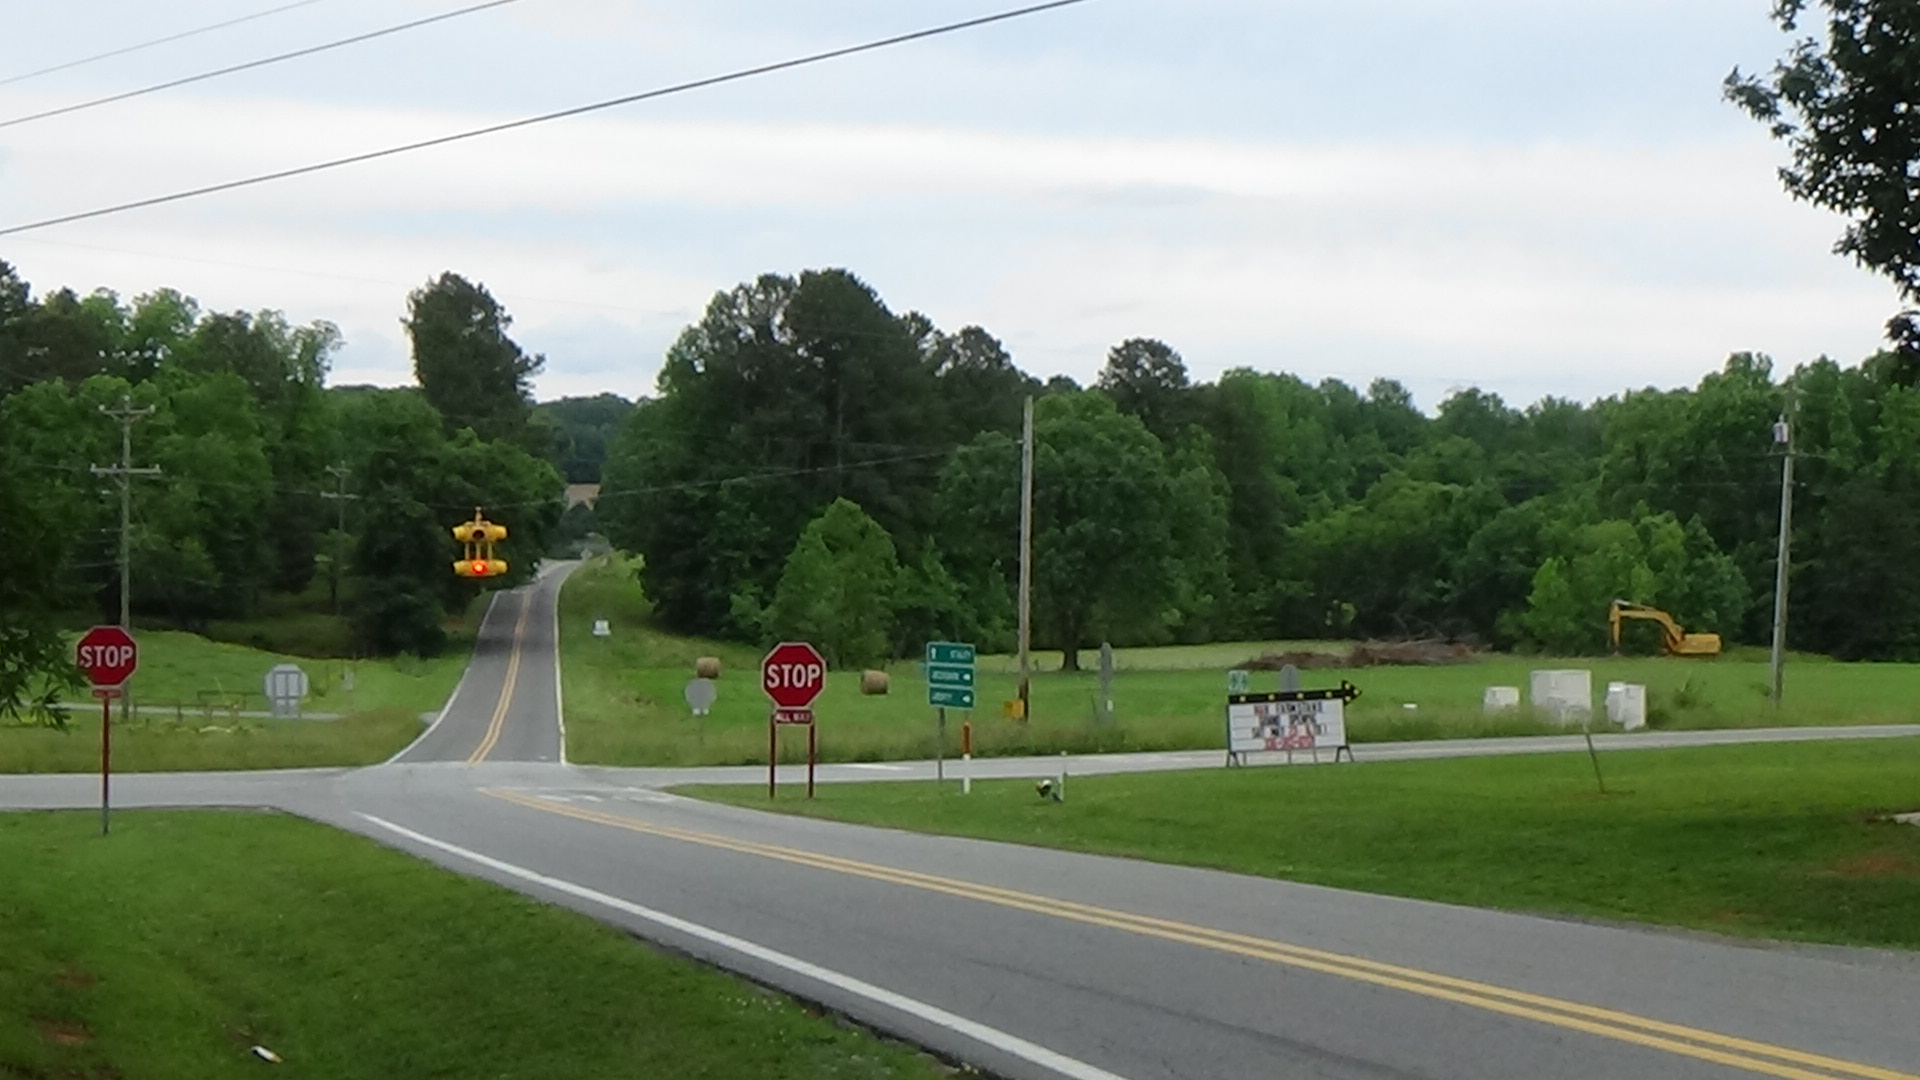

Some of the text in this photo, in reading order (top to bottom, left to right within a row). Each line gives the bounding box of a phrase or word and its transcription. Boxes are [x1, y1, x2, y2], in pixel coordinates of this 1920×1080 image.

[79, 645, 134, 668] STOP
[766, 663, 821, 688] STOP
[775, 713, 791, 722] ALL
